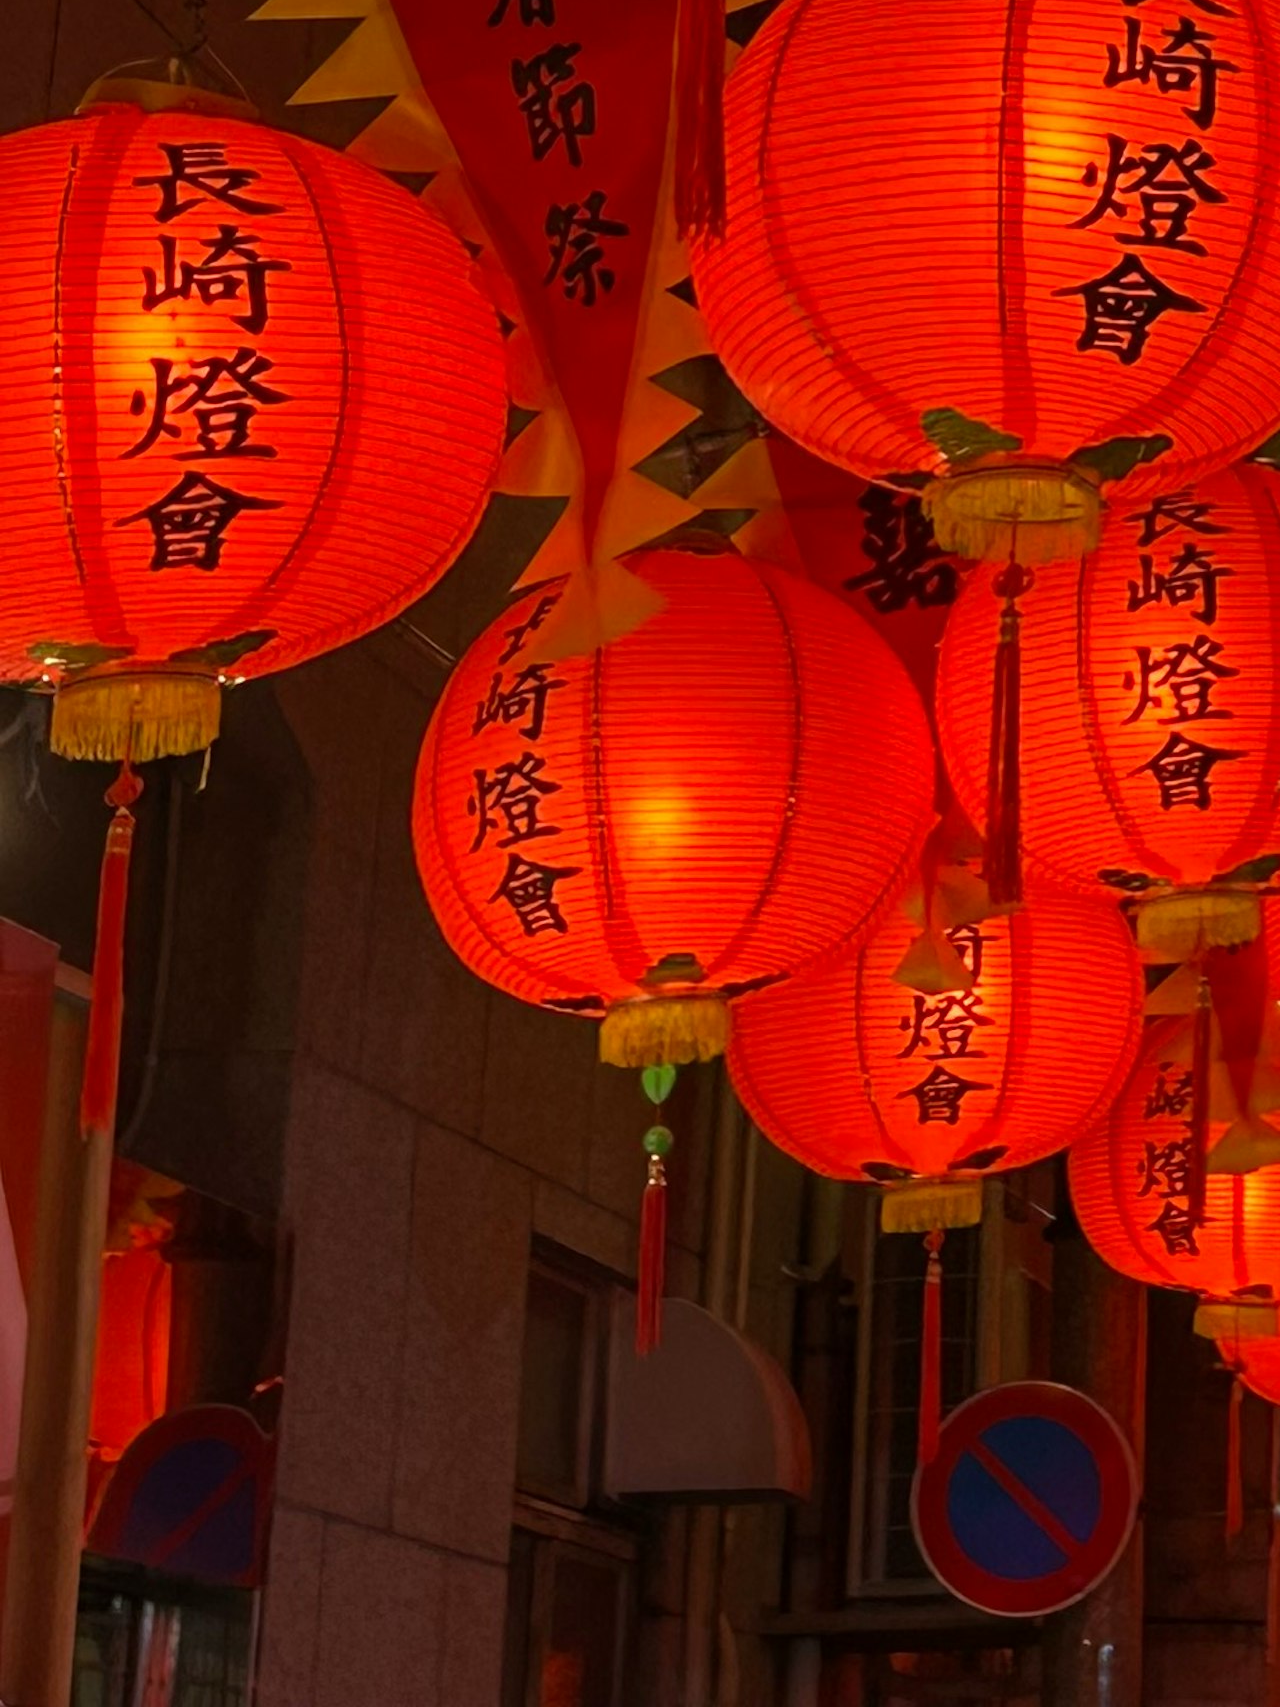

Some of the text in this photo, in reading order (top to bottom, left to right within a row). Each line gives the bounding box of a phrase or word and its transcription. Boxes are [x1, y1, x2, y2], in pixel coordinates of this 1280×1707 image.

[114, 141, 292, 572] 長崎燈會
[1121, 490, 1250, 812] 長崎燈會
